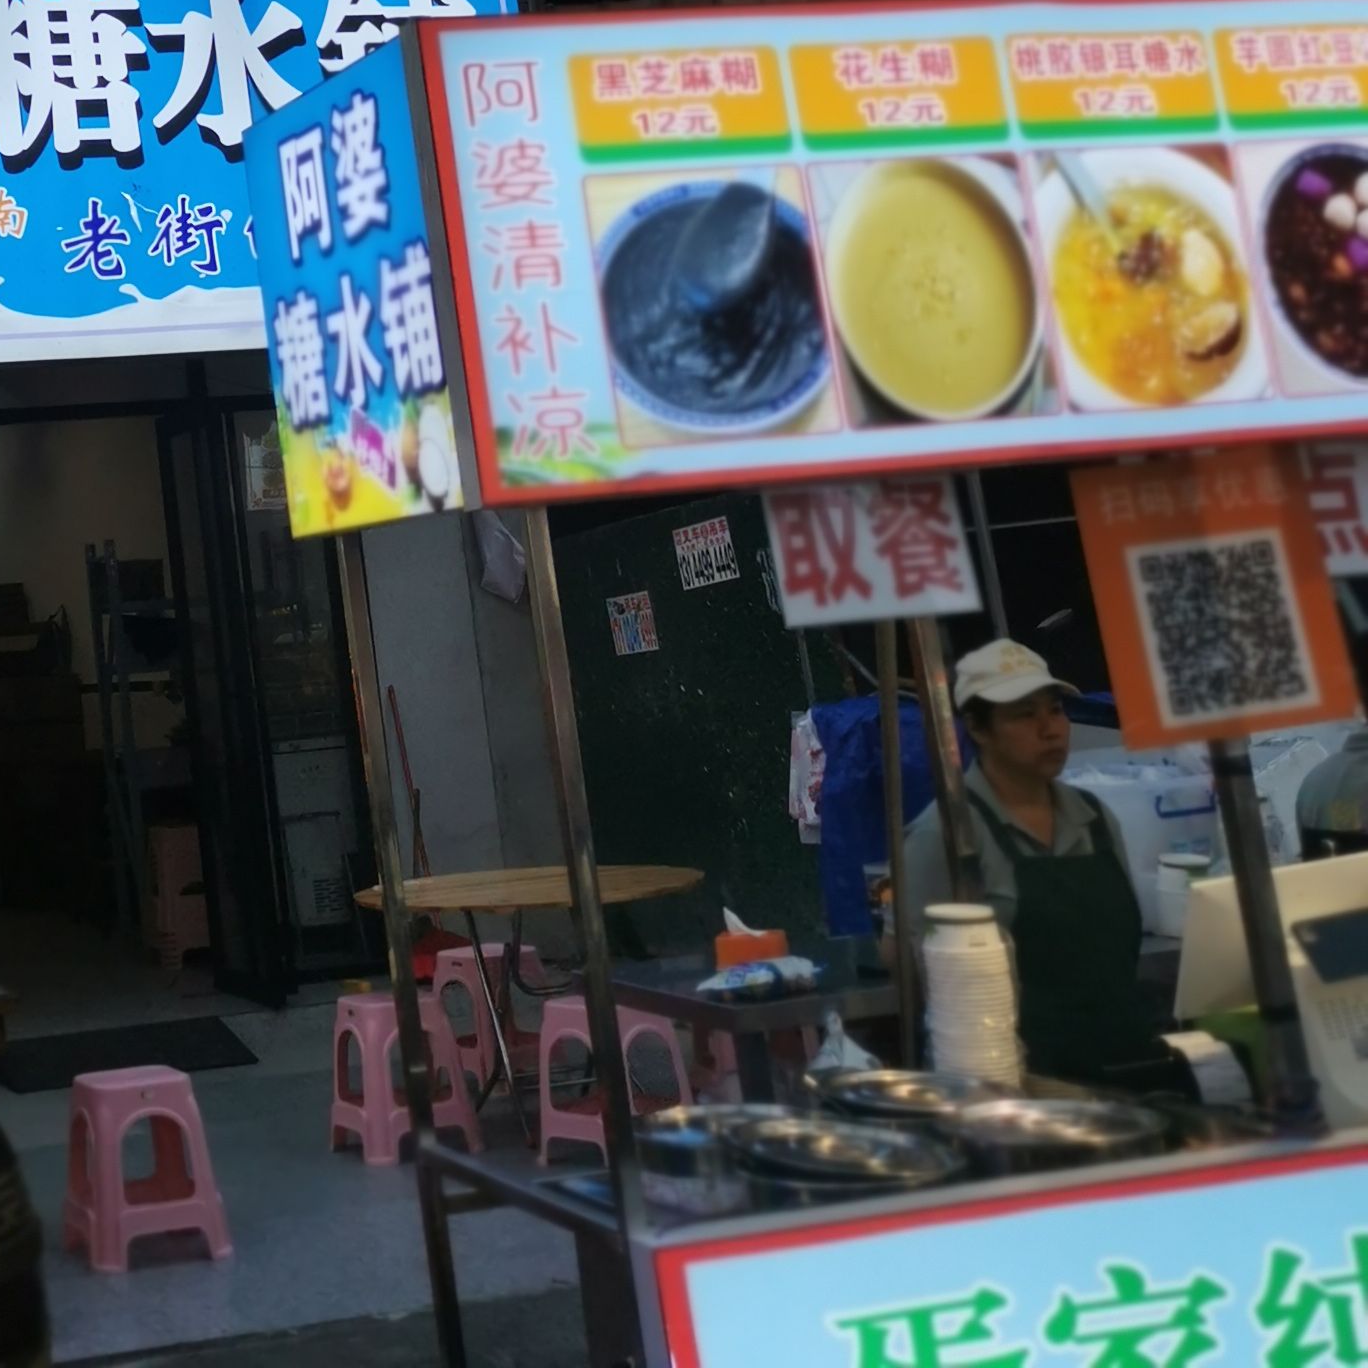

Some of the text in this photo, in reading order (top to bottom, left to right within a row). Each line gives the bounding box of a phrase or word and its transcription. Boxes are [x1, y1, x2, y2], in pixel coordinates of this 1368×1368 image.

[594, 53, 761, 98] 黑芝麻糊
[838, 45, 956, 87] 花生糊
[861, 96, 943, 125] 12元
[1076, 85, 1156, 115] 12元
[1283, 79, 1360, 106] 12元
[635, 108, 717, 137] 12元
[277, 91, 390, 265] 阿婆
[60, 193, 258, 280] 老街
[460, 59, 599, 459] 阿婆清补凉
[272, 236, 446, 431] 糖水铺
